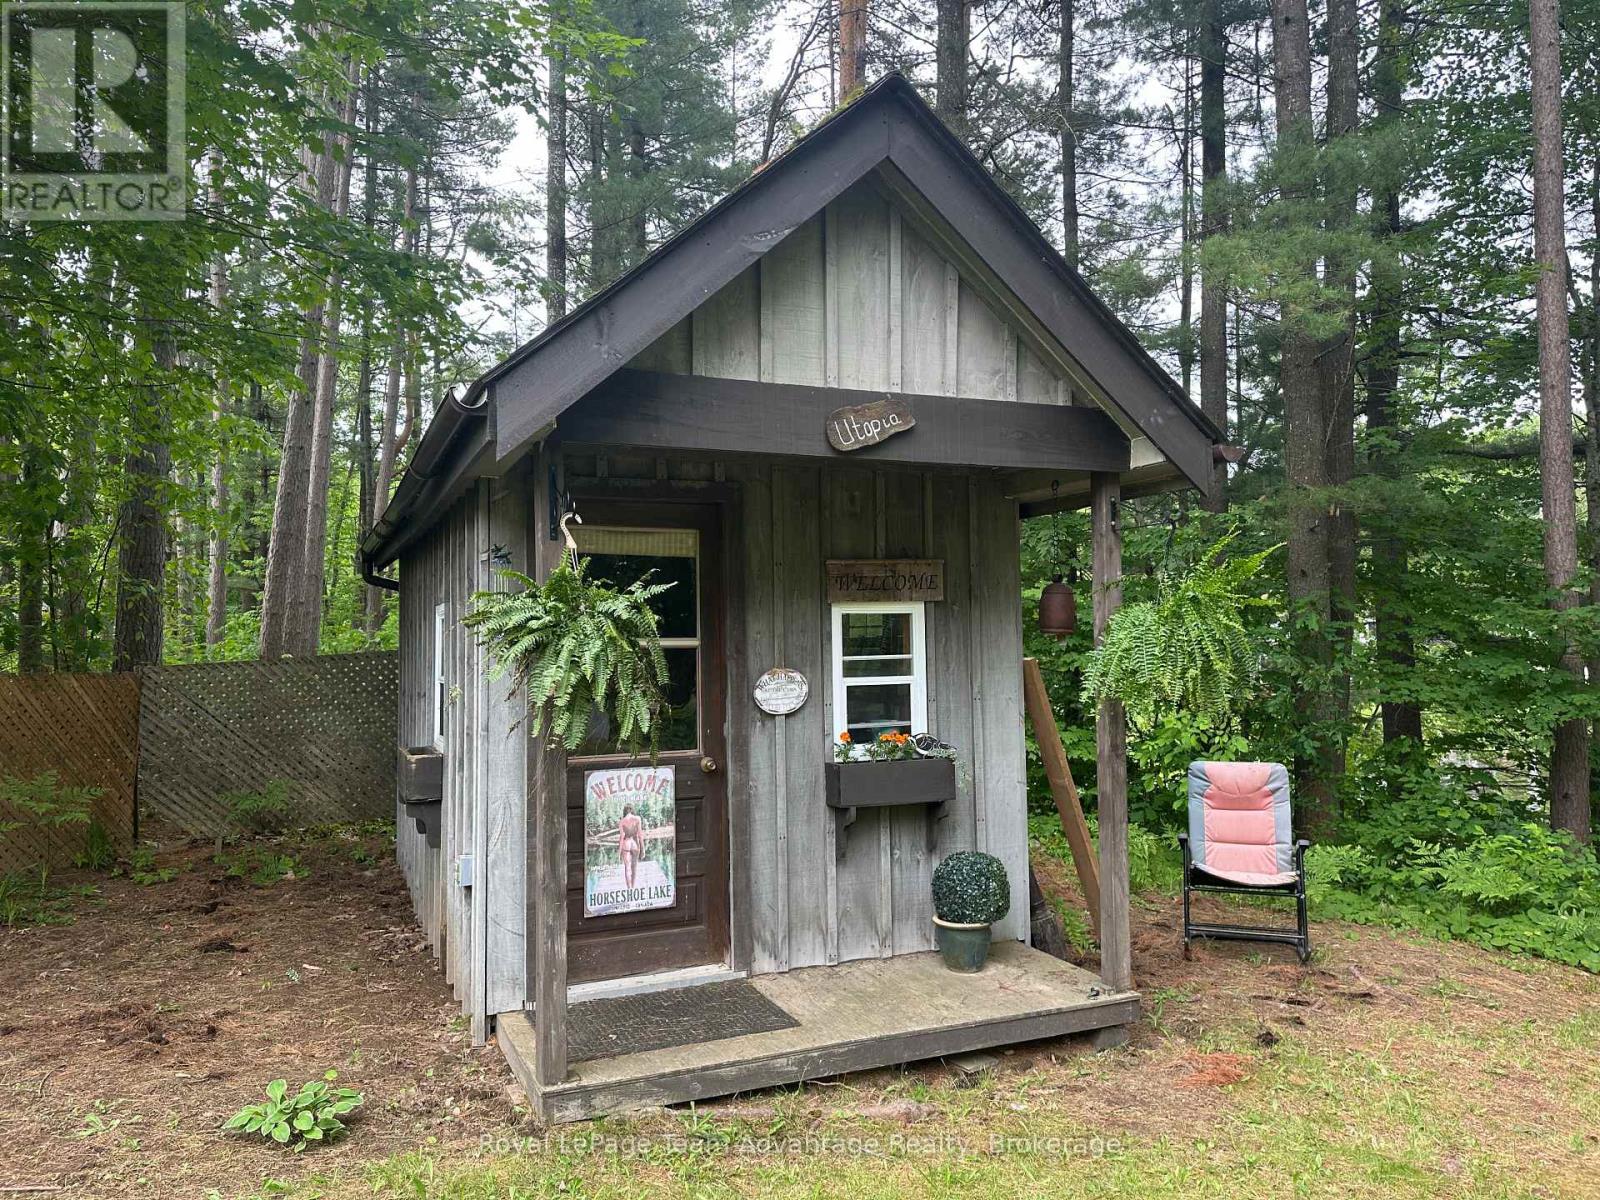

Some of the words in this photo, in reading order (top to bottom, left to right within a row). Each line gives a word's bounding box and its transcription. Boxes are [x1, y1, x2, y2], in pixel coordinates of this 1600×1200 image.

[834, 413, 902, 445] Utopia
[835, 572, 938, 591] WELCOME
[591, 773, 669, 800] WELCOME
[589, 887, 646, 907] HORSESHOE
[649, 884, 672, 899] LAKE
